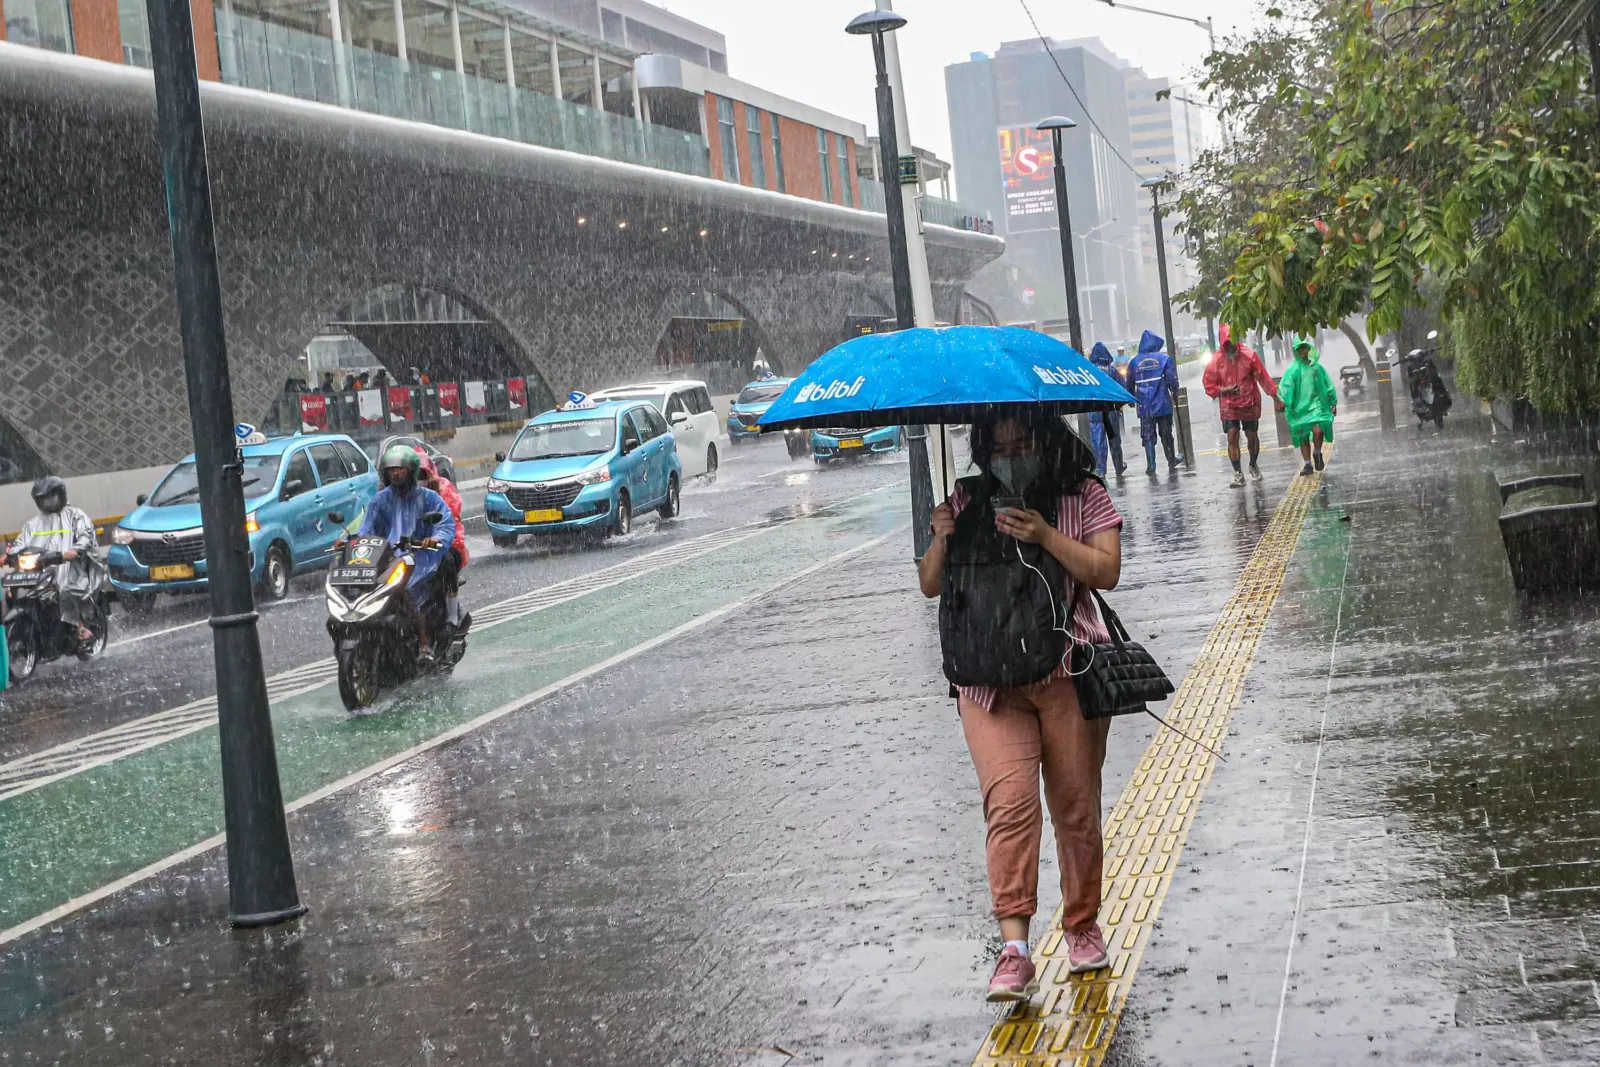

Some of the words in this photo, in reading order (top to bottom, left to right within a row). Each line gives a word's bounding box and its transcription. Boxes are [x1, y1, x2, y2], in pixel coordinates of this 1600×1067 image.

[1026, 189, 1054, 197] AVAILABLE
[1045, 366, 1100, 386] blibli
[810, 376, 866, 402] blibli
[551, 421, 584, 429] Bluebird
